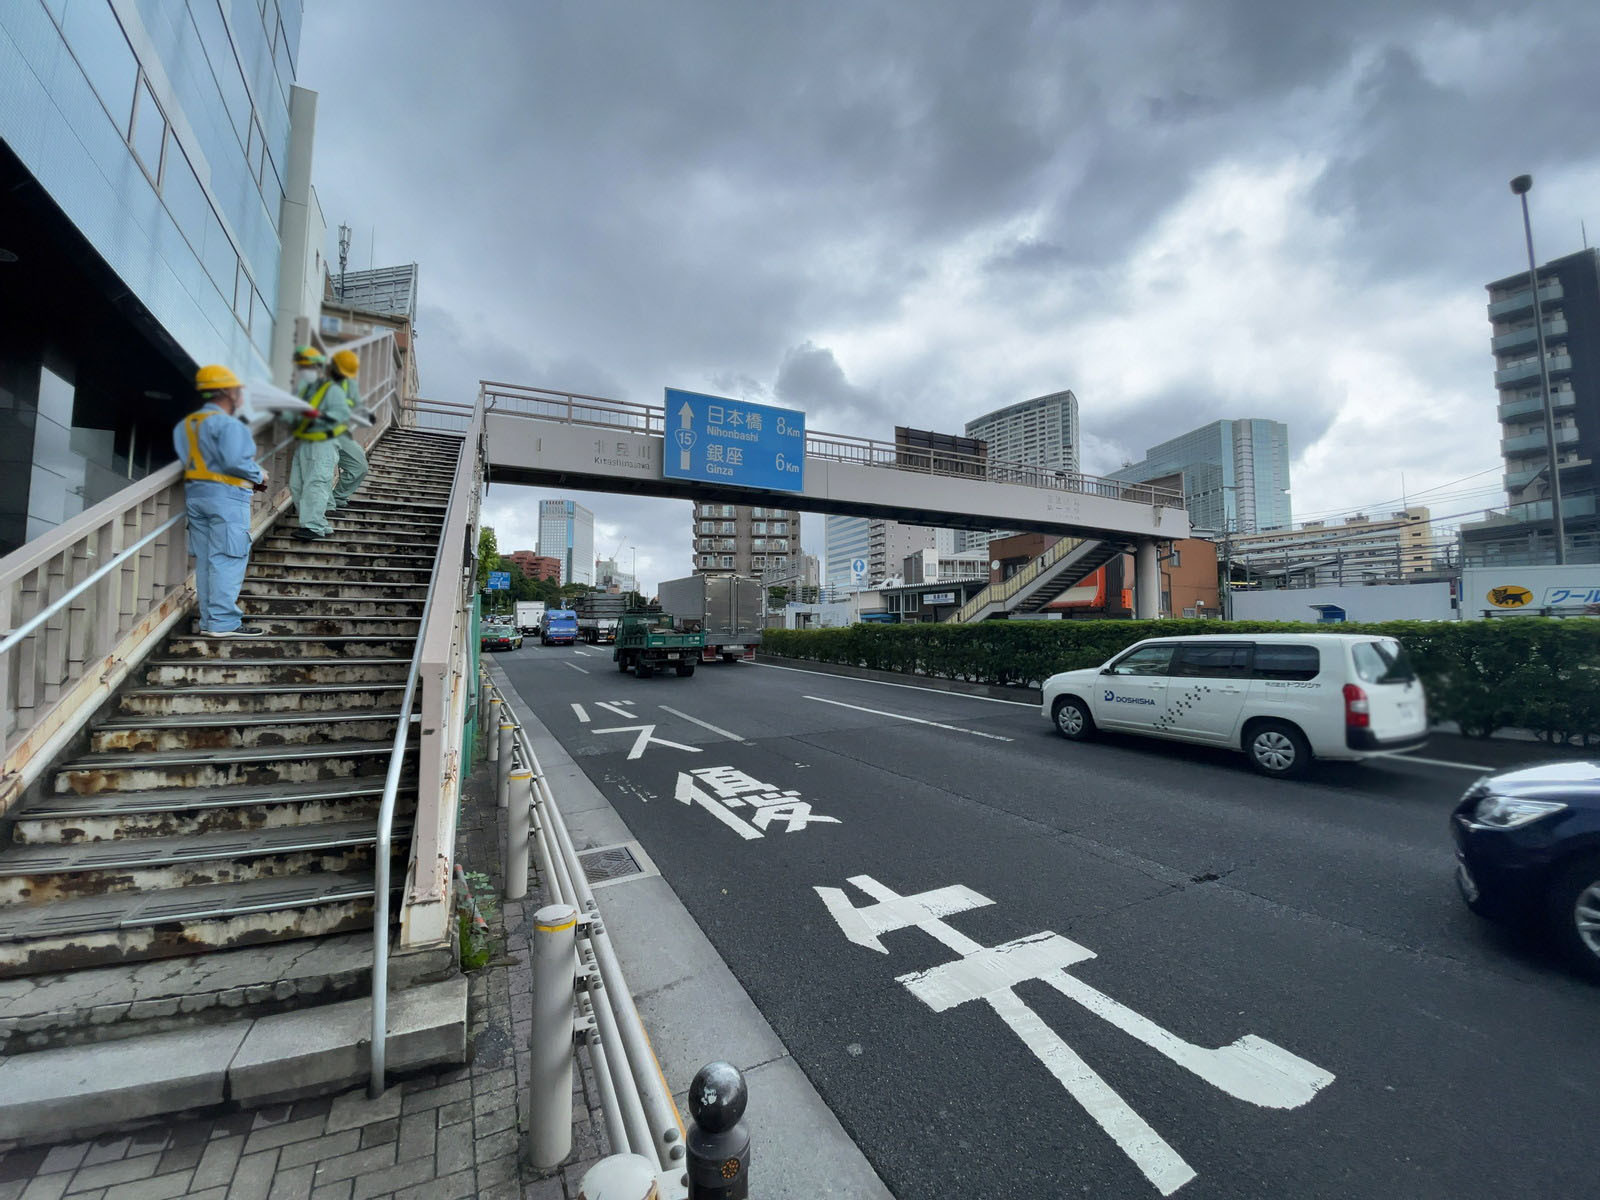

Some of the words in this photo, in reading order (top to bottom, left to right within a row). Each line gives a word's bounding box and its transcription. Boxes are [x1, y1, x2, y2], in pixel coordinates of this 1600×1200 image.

[708, 405, 763, 431] 日本橋
[679, 431, 692, 445] 15
[706, 425, 759, 442] Nihonbashi
[706, 443, 744, 466] 銀座
[706, 463, 734, 476] Ginza
[1116, 696, 1156, 705] DOSHISHA
